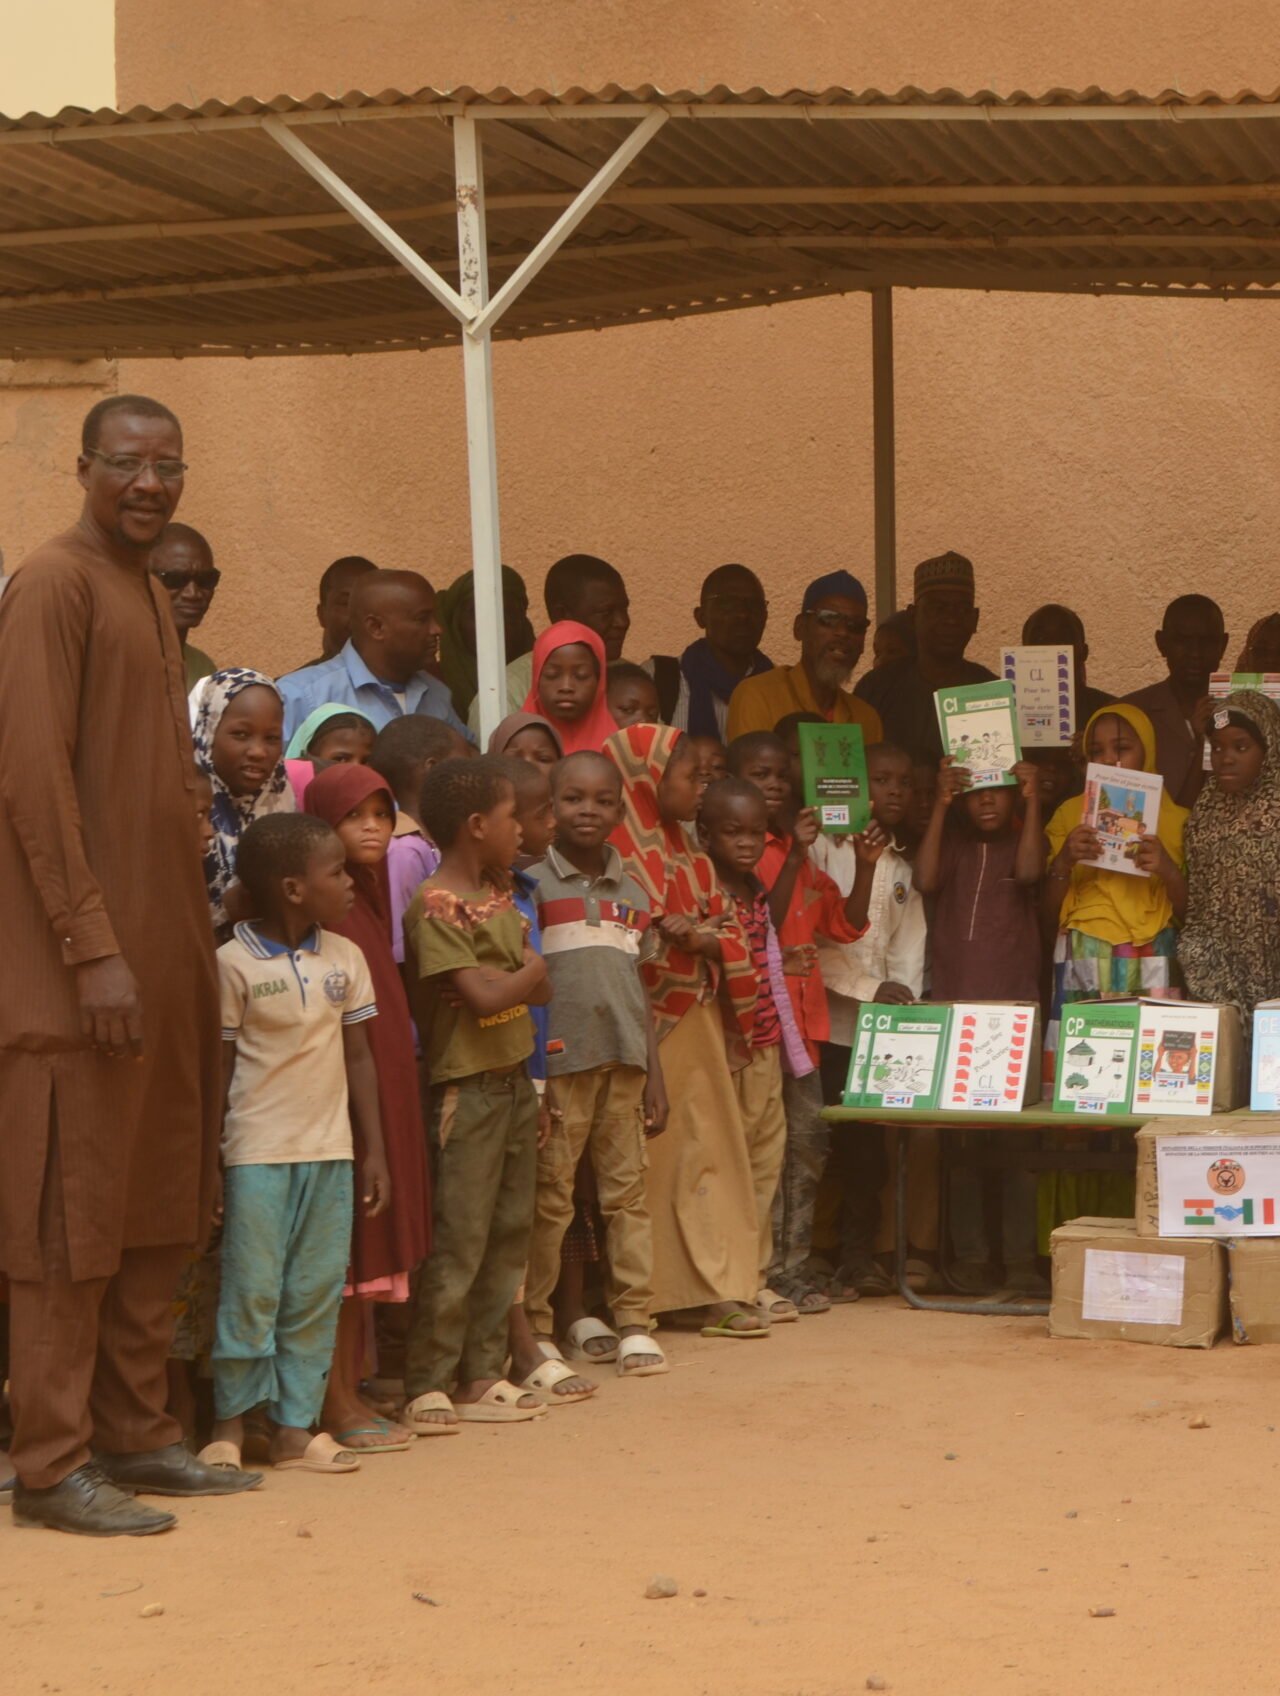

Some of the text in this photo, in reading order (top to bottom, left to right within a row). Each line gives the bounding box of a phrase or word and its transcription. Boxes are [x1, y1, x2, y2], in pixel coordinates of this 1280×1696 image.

[943, 697, 958, 713] CI
[252, 978, 290, 999] IKRAA
[861, 1013, 873, 1029] C
[876, 1014, 892, 1030] CI
[1066, 1017, 1085, 1036] CP
